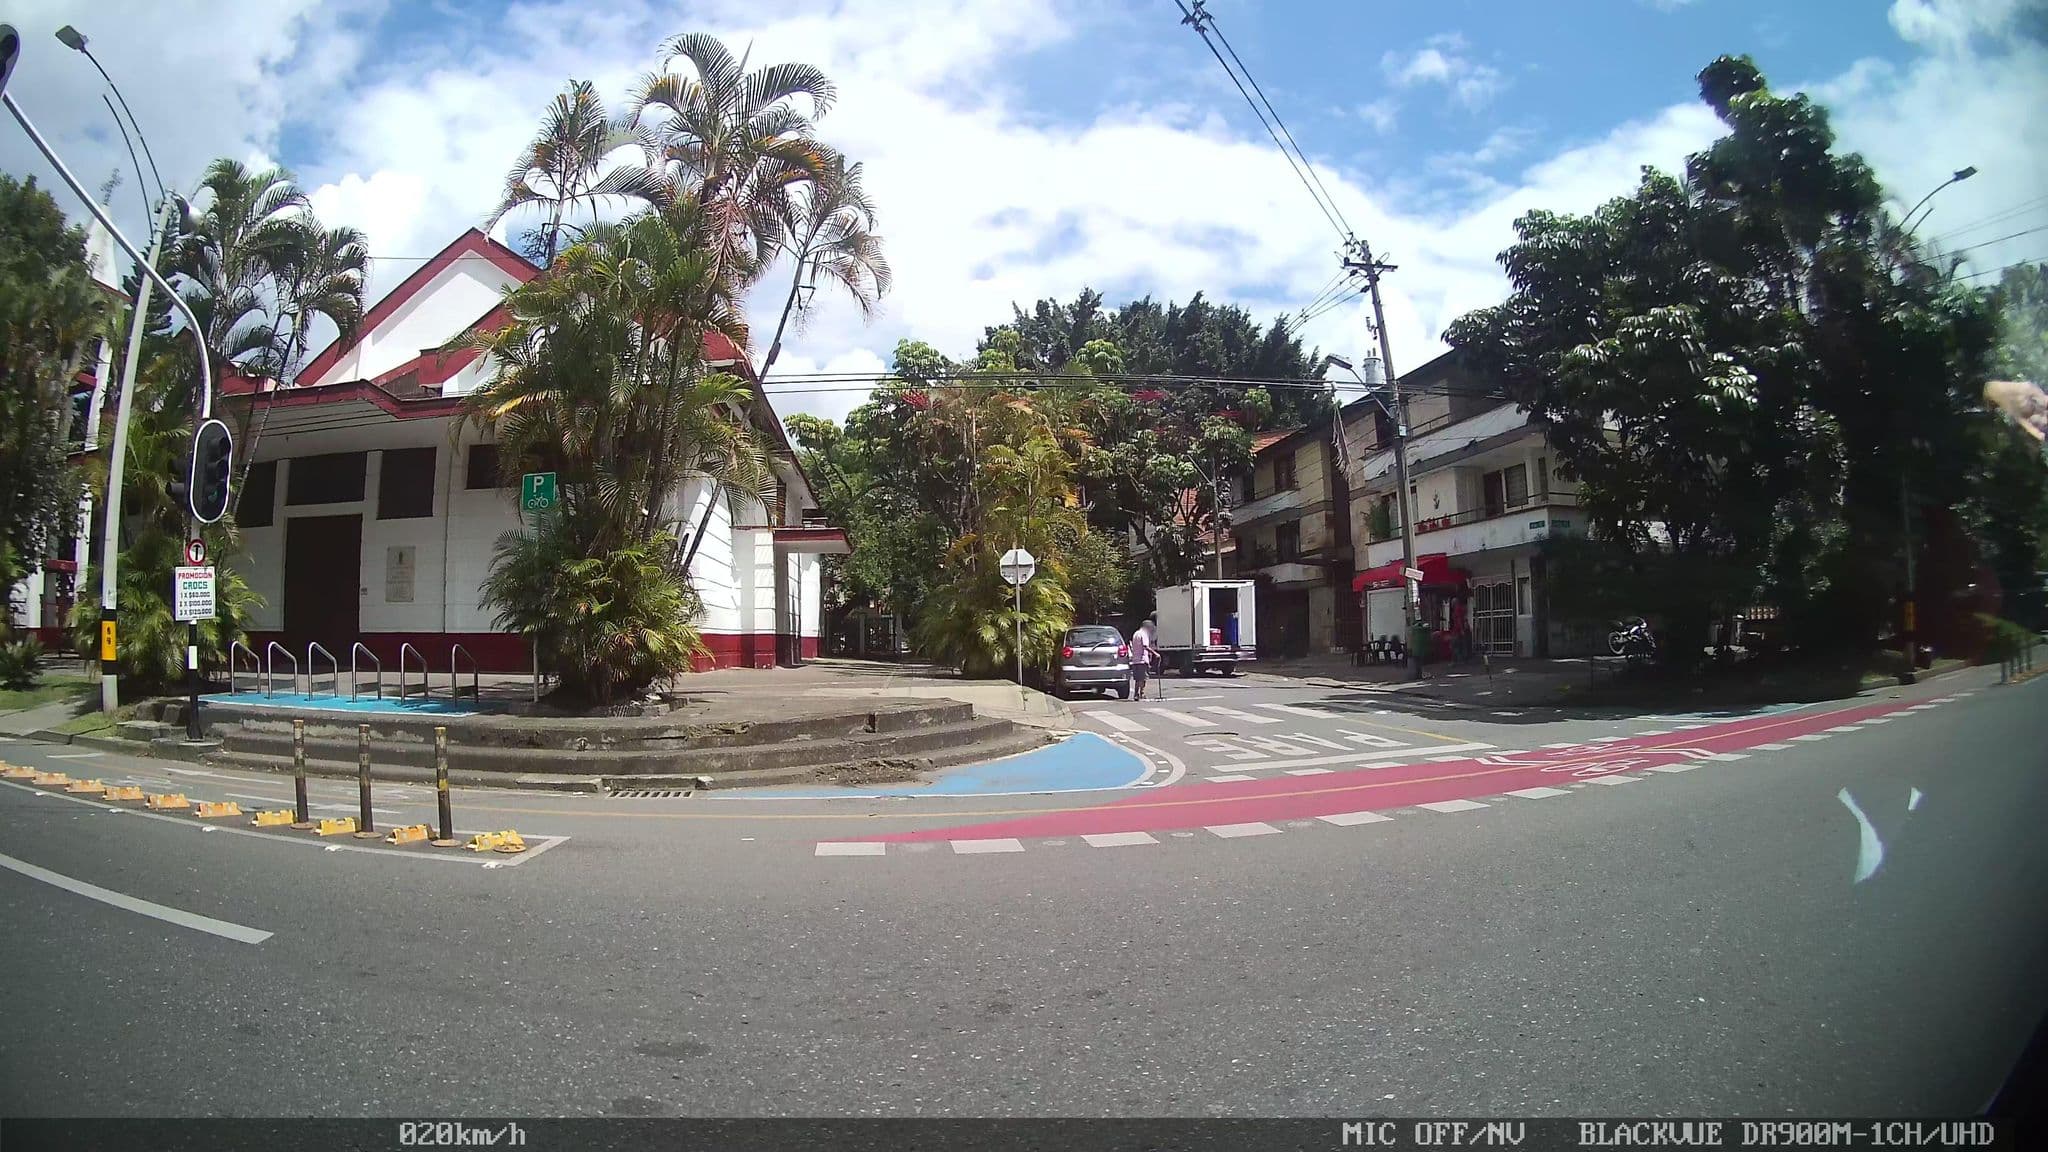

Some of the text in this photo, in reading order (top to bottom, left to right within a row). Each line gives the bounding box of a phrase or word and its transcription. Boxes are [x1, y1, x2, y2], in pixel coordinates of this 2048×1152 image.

[533, 475, 544, 493] P
[183, 581, 208, 590] CROCS
[1184, 729, 1411, 759] PARE
